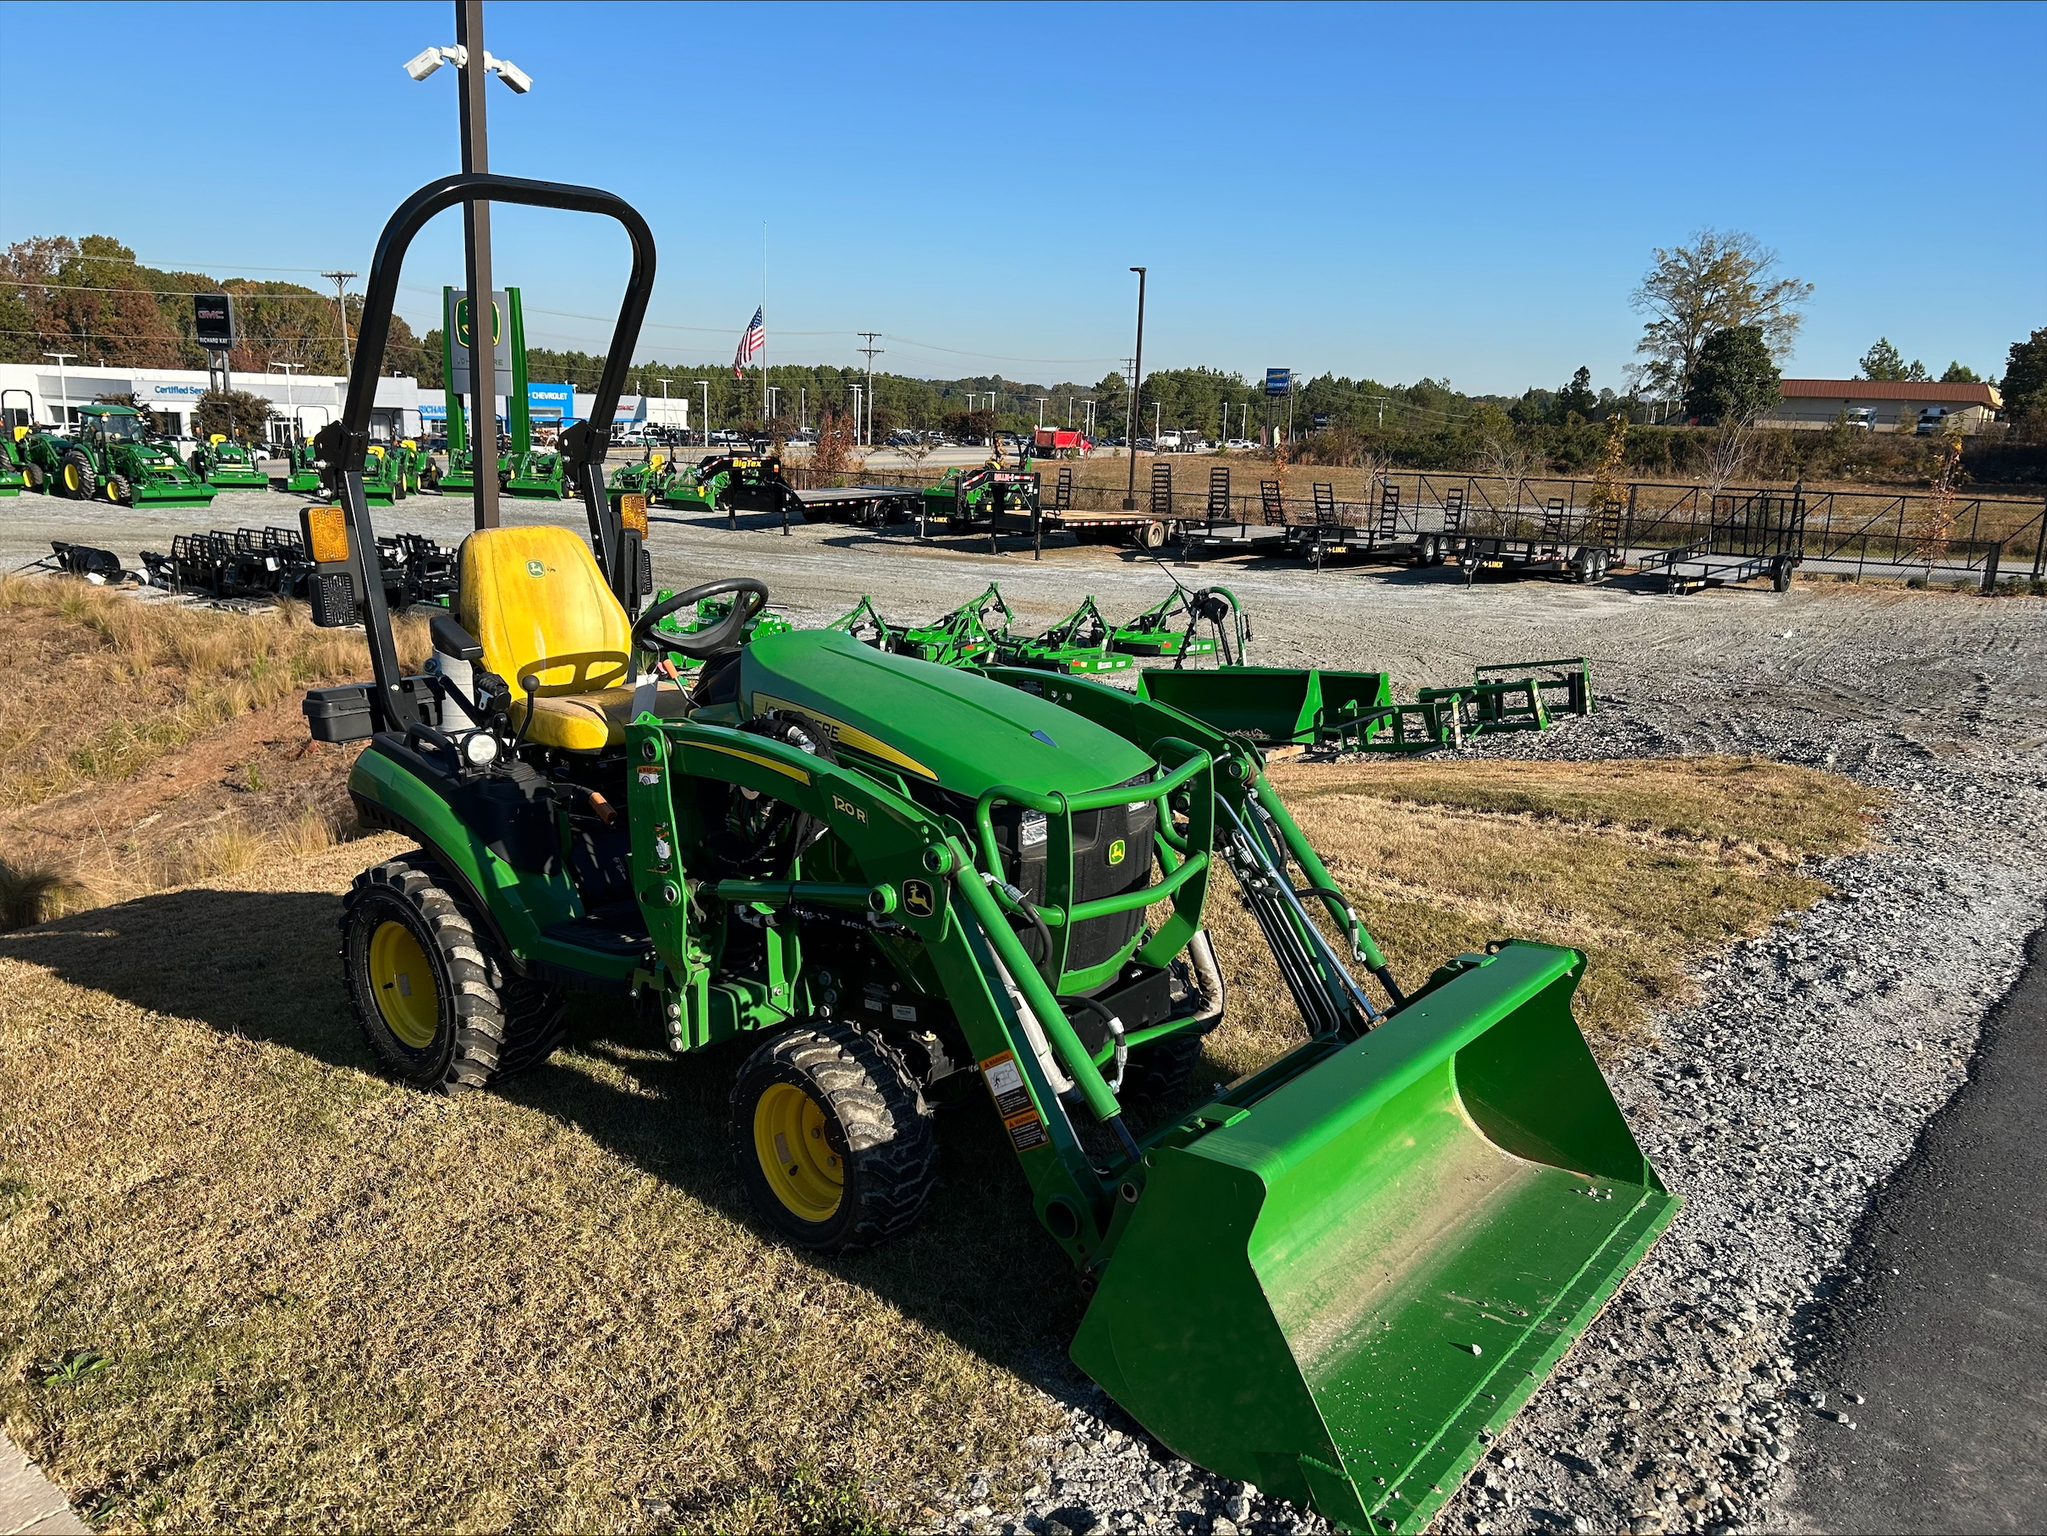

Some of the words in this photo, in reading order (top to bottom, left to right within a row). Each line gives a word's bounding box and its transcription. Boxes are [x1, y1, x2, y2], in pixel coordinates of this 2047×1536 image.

[198, 310, 224, 319] GMC
[154, 385, 188, 395] Certified
[532, 392, 568, 400] CHEVROLET
